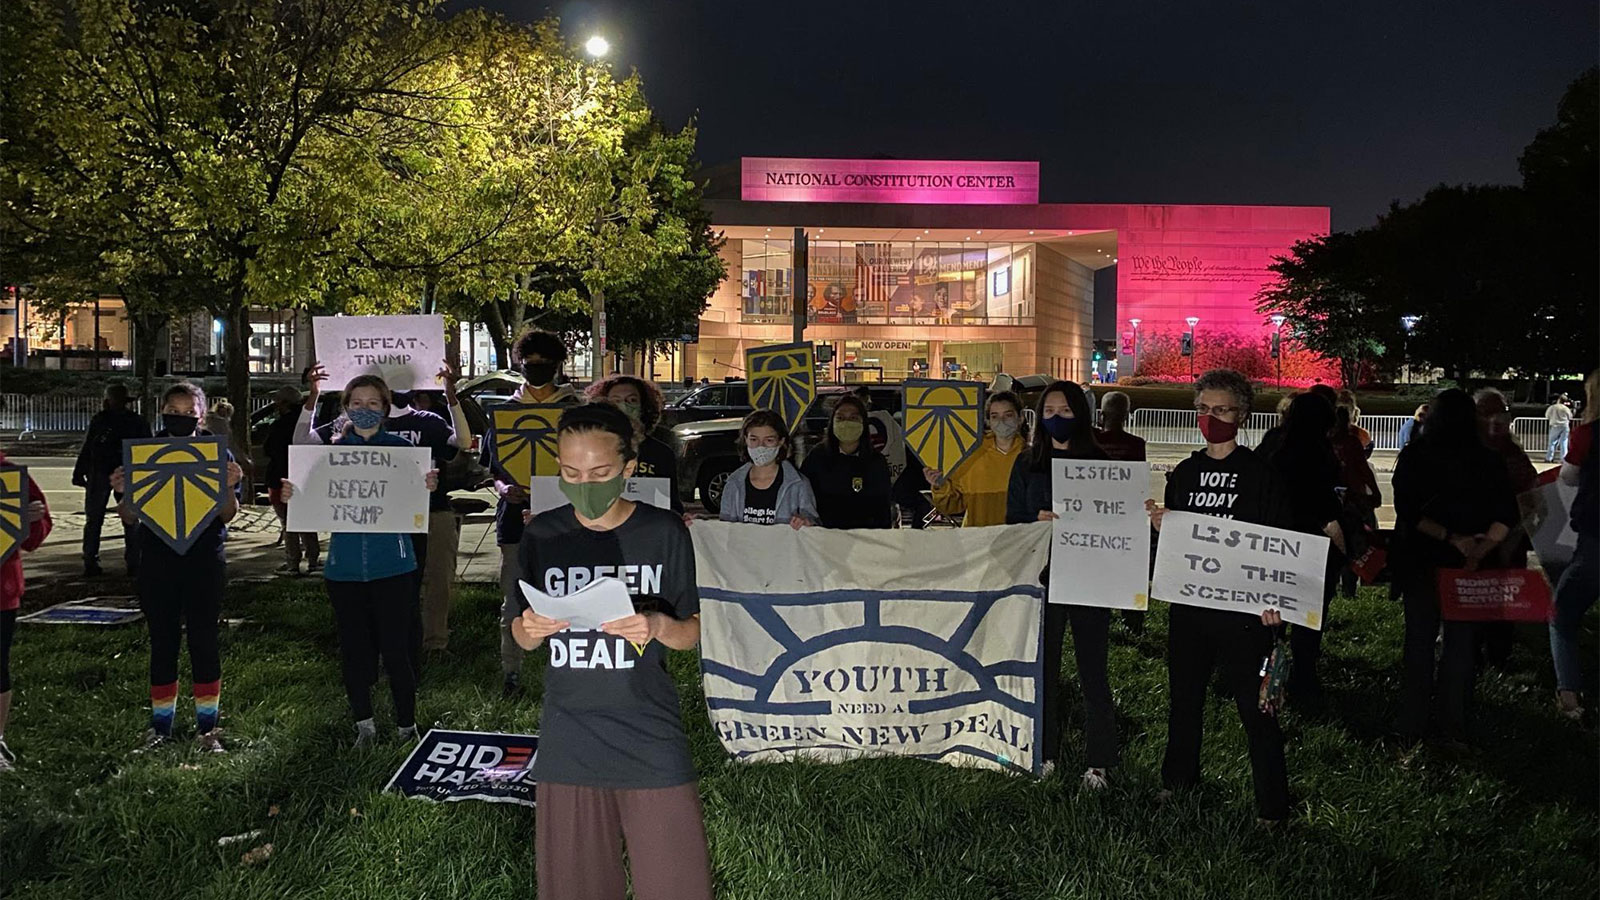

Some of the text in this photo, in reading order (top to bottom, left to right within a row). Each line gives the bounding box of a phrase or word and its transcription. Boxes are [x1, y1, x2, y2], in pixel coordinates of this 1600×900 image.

[766, 172, 1016, 188] NATIONAL CONSTITUTION CENTER
[1132, 255, 1150, 272] We
[1150, 255, 1167, 273] the
[1167, 255, 1203, 273] People
[861, 341, 911, 349] NOW OPEN!
[354, 354, 412, 366] TRUMP
[1064, 465, 1131, 481] LISTEN
[1200, 471, 1238, 489] VOTE
[328, 479, 389, 499] DEFEAT
[1063, 498, 1127, 515] TO THE
[1188, 492, 1239, 509] TODAY
[331, 504, 384, 524] TRUMP
[1060, 531, 1132, 551] SCIENCE
[1192, 523, 1301, 558] LISTEN
[1184, 553, 1297, 586] TO THE
[1179, 583, 1299, 612] SCIENCE
[550, 638, 635, 669] DEAL
[792, 665, 949, 694] YOUTH
[837, 703, 905, 715] NEED A
[714, 713, 1030, 752] GREEN NEW DEAL
